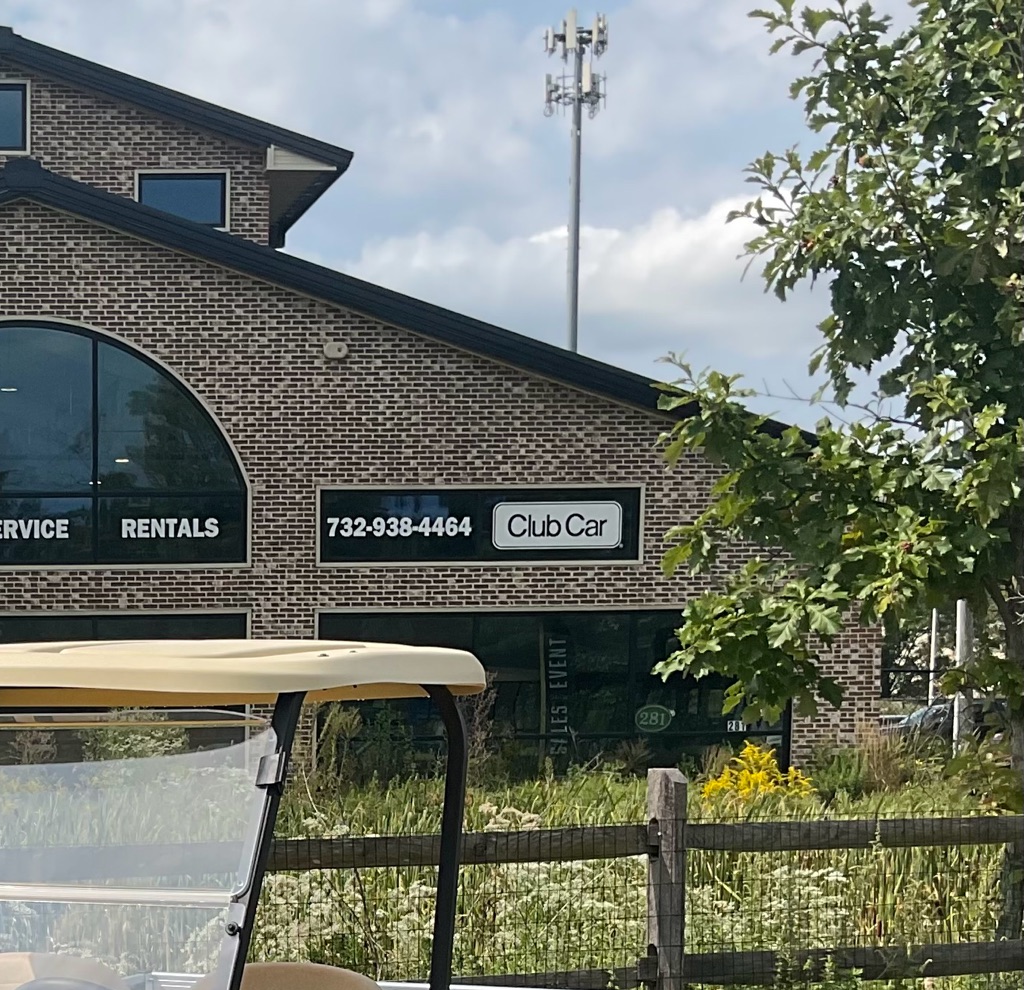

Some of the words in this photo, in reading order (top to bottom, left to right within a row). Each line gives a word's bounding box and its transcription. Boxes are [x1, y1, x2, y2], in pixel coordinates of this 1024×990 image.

[121, 517, 219, 539] RENTALS
[327, 516, 472, 537] 732-938-4464
[507, 513, 562, 538] Club
[565, 513, 607, 537] Car
[549, 638, 568, 689] EVENT
[639, 711, 664, 726] 281
